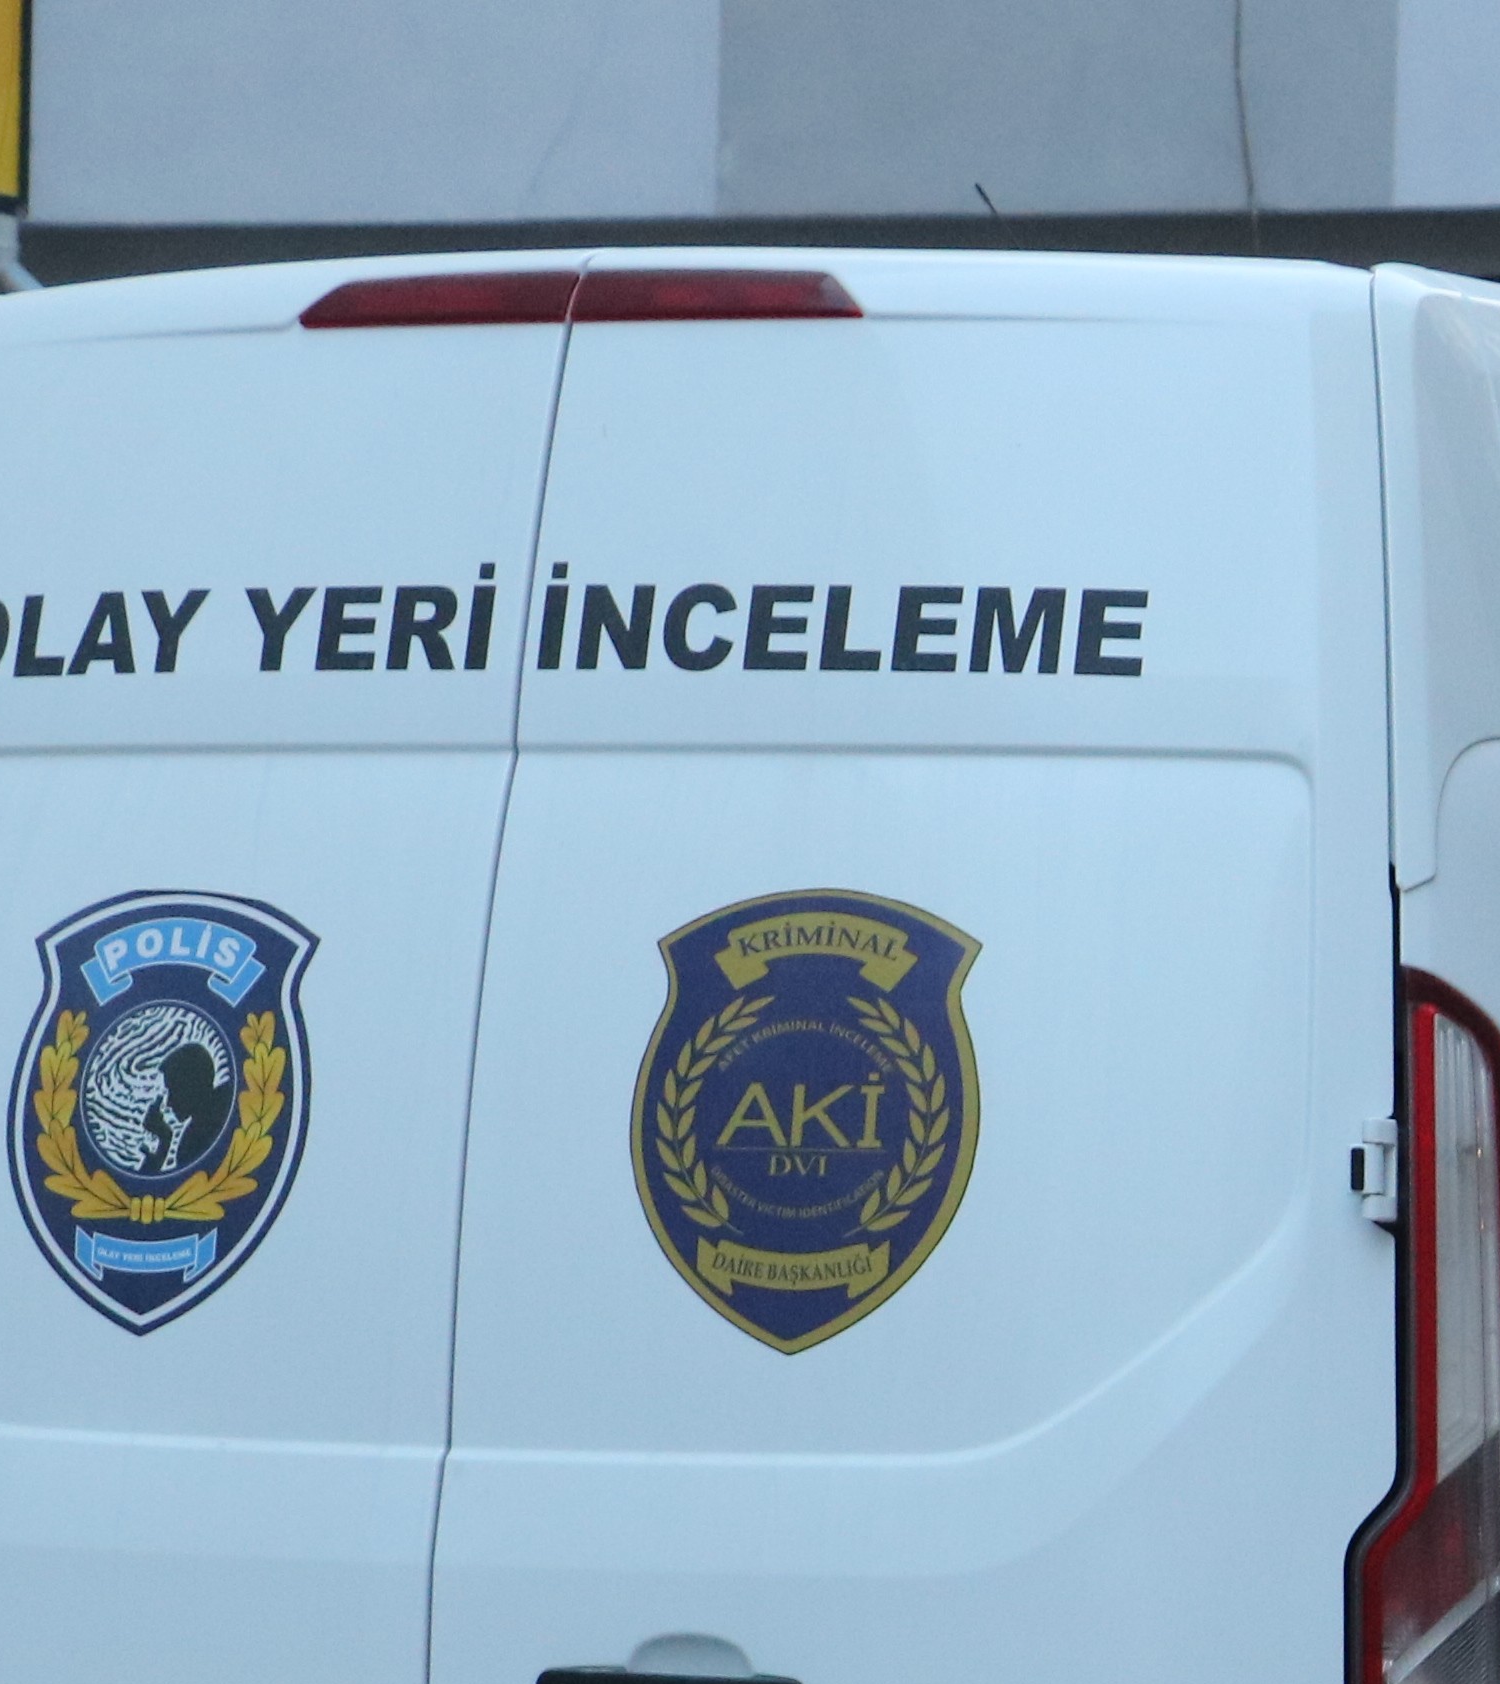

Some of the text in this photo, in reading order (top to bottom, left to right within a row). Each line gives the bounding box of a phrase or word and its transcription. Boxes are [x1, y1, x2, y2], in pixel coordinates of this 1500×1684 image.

[243, 562, 498, 674] YERİ
[536, 561, 1149, 676] İNCELEME
[102, 922, 242, 972] POLİS
[737, 920, 901, 963] KRİMİNAL
[715, 1072, 886, 1149] AKİ
[768, 1154, 828, 1177] DVI
[711, 1251, 873, 1286] DAİRE BAŞKANLIĞI
